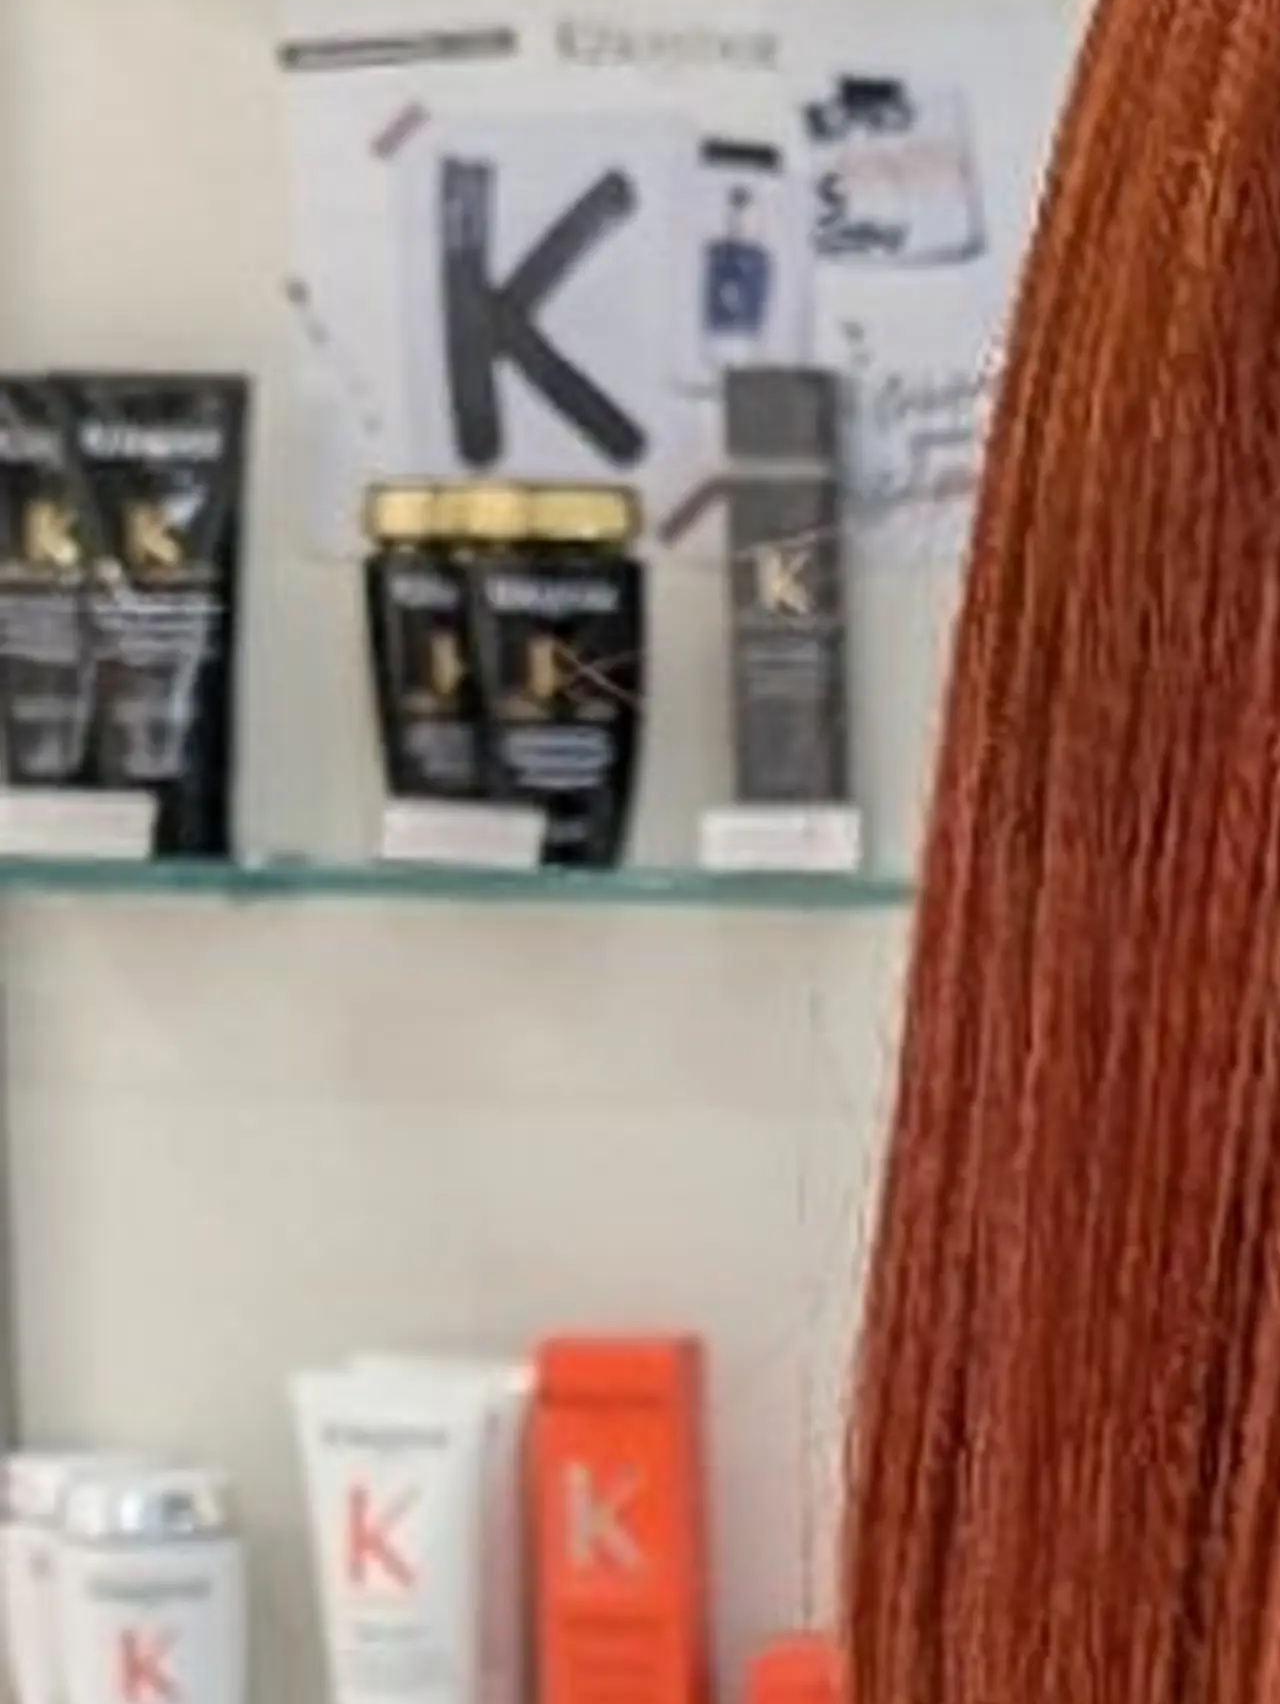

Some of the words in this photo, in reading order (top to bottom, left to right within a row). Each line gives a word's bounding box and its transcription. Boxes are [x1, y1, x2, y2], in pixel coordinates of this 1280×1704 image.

[440, 154, 648, 468] K
[760, 544, 814, 616] K
[346, 1484, 423, 1586] K
[564, 1460, 652, 1572] K
[118, 1626, 182, 1704] K
